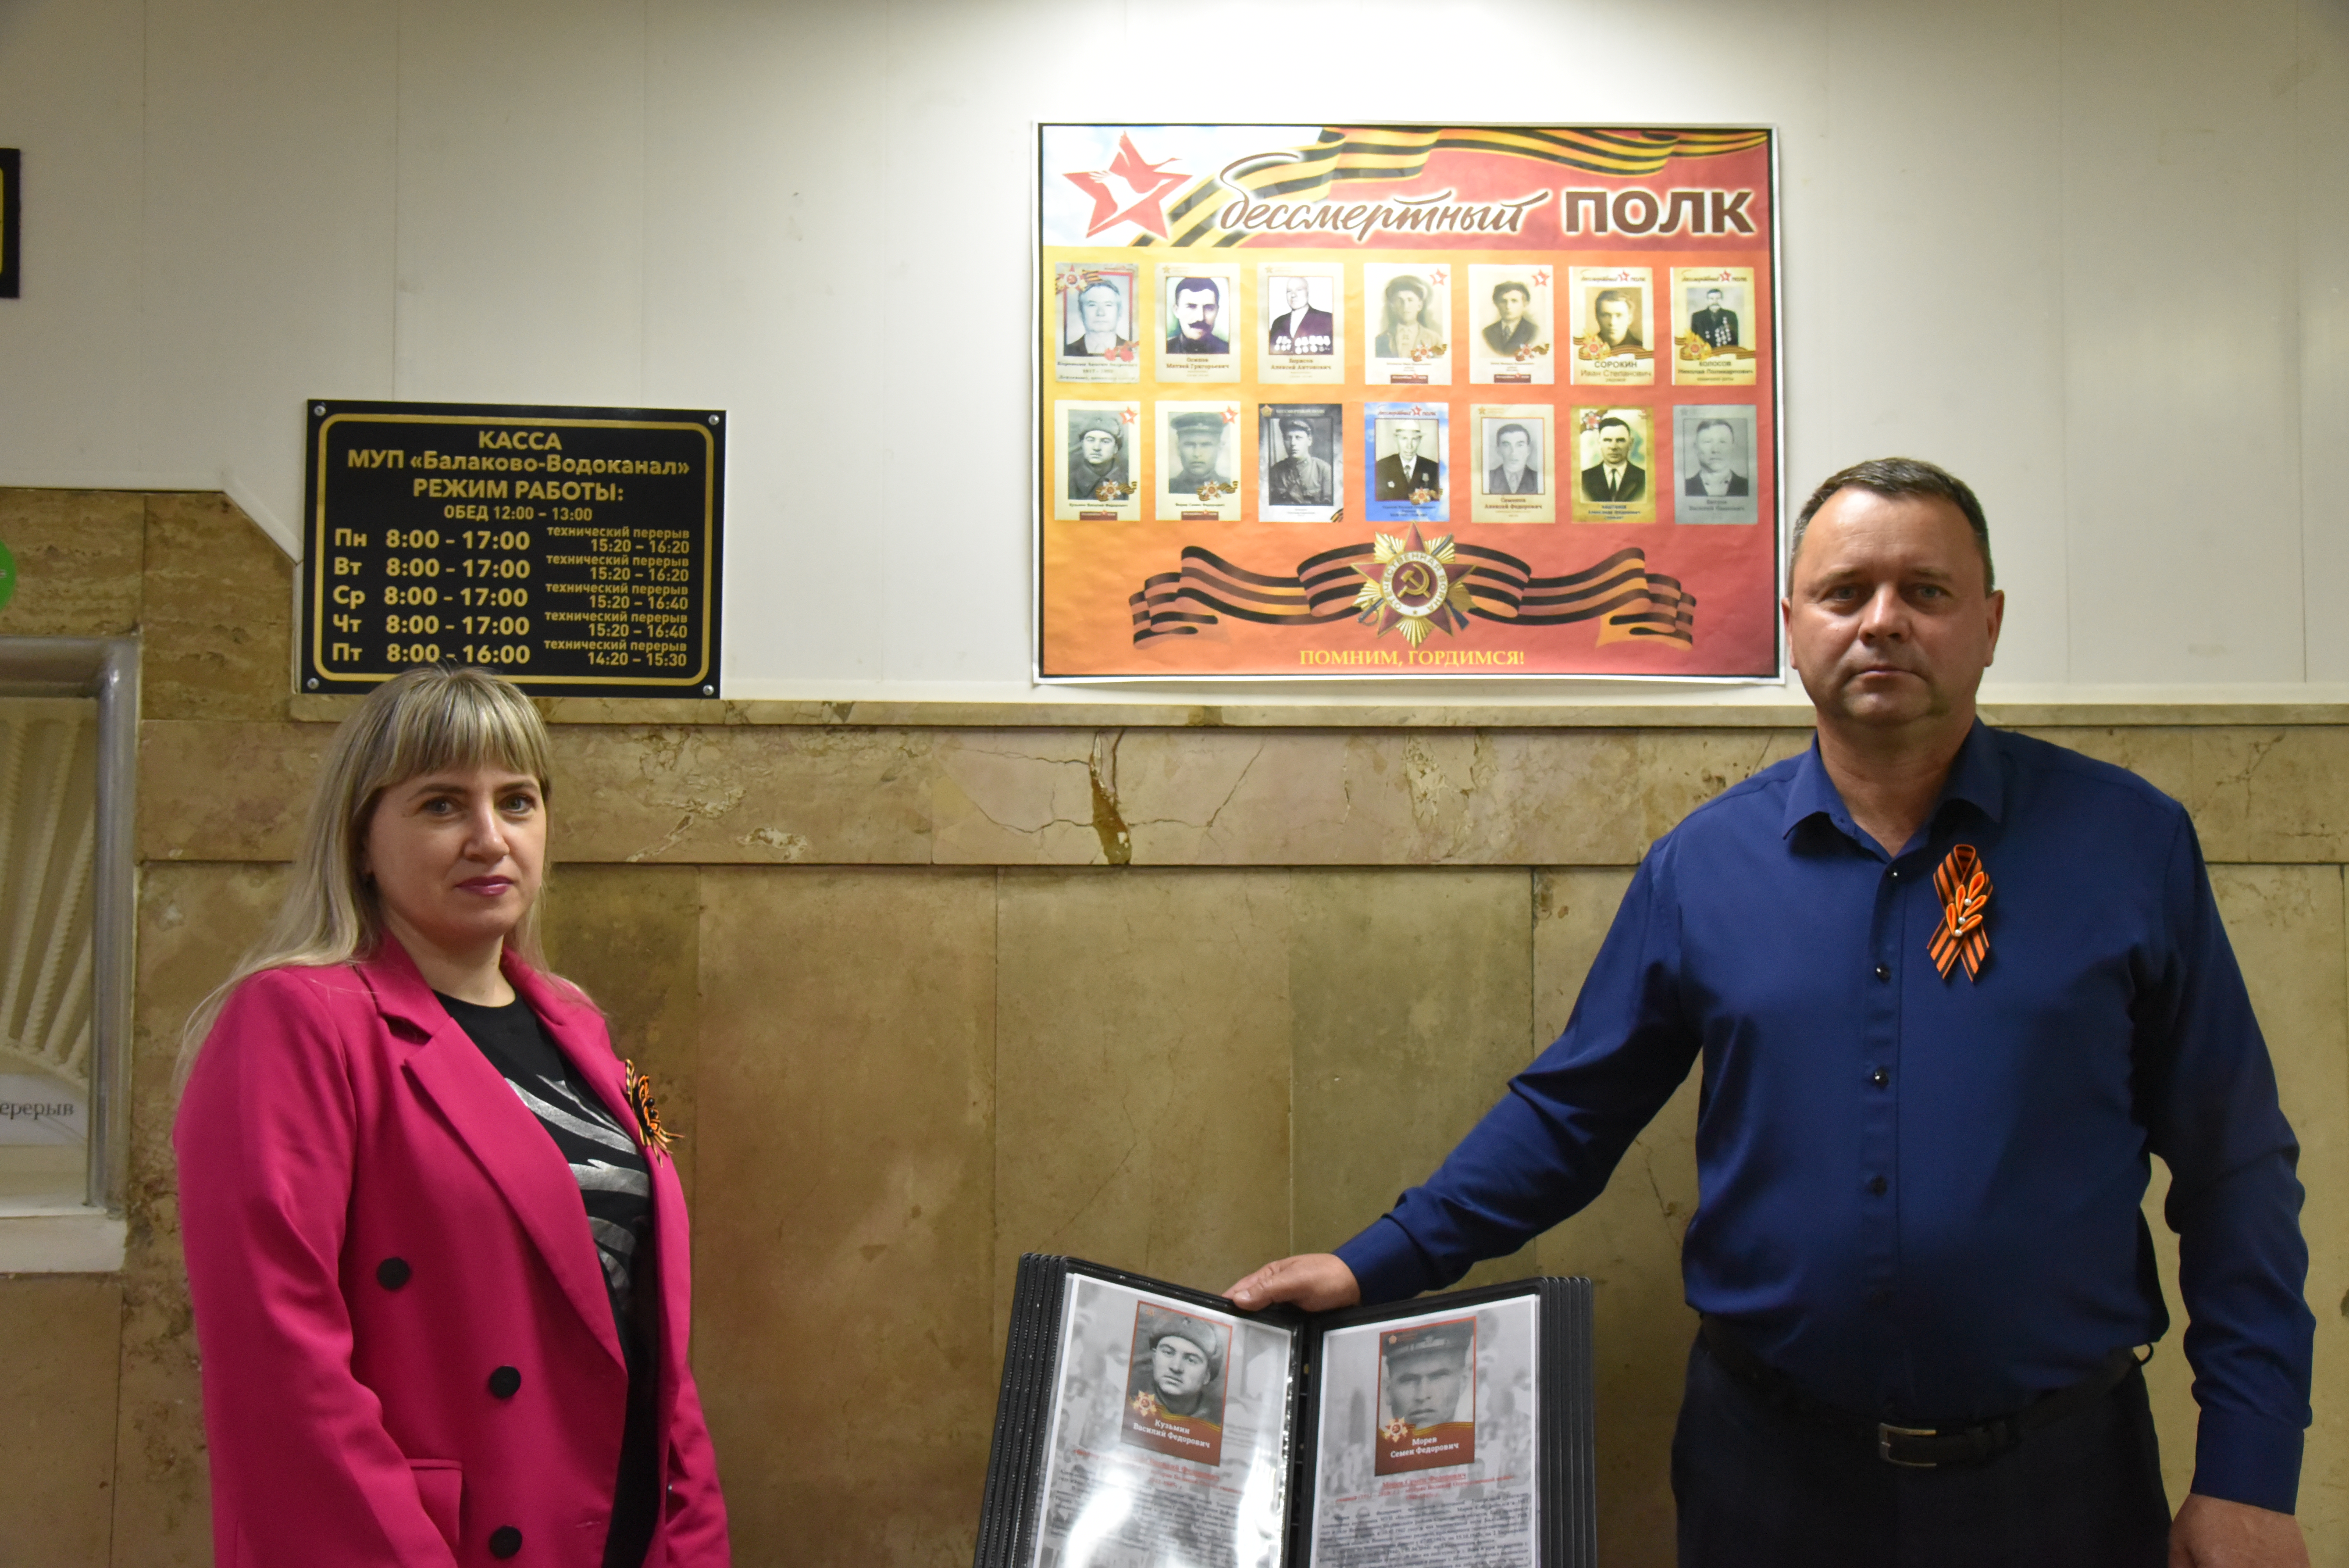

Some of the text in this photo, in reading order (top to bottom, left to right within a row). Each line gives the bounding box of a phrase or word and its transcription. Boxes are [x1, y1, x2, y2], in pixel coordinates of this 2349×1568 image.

[1566, 190, 1755, 234] ПОЛК
[479, 431, 562, 450] КАССА
[348, 450, 689, 475] МУП «Балаково-Водоканал»
[414, 479, 623, 501] РЕЖИМ РАБОТЫ:
[444, 505, 488, 521] ОБЕД
[494, 506, 533, 519] 12:00
[553, 508, 592, 520] 13:00
[335, 529, 367, 546] Пн
[386, 529, 439, 548] 8:00
[463, 531, 530, 549] 17:00
[547, 527, 689, 541] технический перерыв
[592, 539, 631, 552] 15:20
[650, 539, 689, 553] 16:20
[335, 557, 362, 575] Вт
[386, 558, 439, 577] 8:00
[463, 559, 530, 578] 17:00
[547, 555, 688, 569] технический перерыв
[591, 567, 630, 580] 15:20
[649, 568, 688, 581] 16:20
[333, 585, 365, 608] Ср
[384, 586, 437, 605] 8:00
[461, 588, 528, 606] 17:00
[546, 583, 688, 598] технический перерыв
[590, 595, 629, 608] 15:20
[649, 597, 688, 609] 16:40
[333, 614, 362, 632] Чт
[386, 615, 439, 634] 8:00
[462, 617, 529, 635] 17:00
[545, 611, 687, 626] технический перерыв
[589, 624, 629, 637] 15:20
[648, 625, 687, 638] 16:40
[333, 643, 362, 661] Пт
[387, 644, 439, 663] 8:00
[463, 645, 530, 663] 16:00
[544, 640, 686, 654] технический перерыв
[588, 652, 628, 665] 14:20
[647, 652, 686, 666] 15:30
[1299, 650, 1524, 667] ПОМНИМ, ГОРДИМСЯ!
[1155, 1419, 1190, 1434] Кузьмин
[1133, 1422, 1167, 1438] Василий
[1167, 1431, 1210, 1449] Федорович
[1412, 1437, 1438, 1446] Морев
[1390, 1443, 1459, 1458] Семен Федорович
